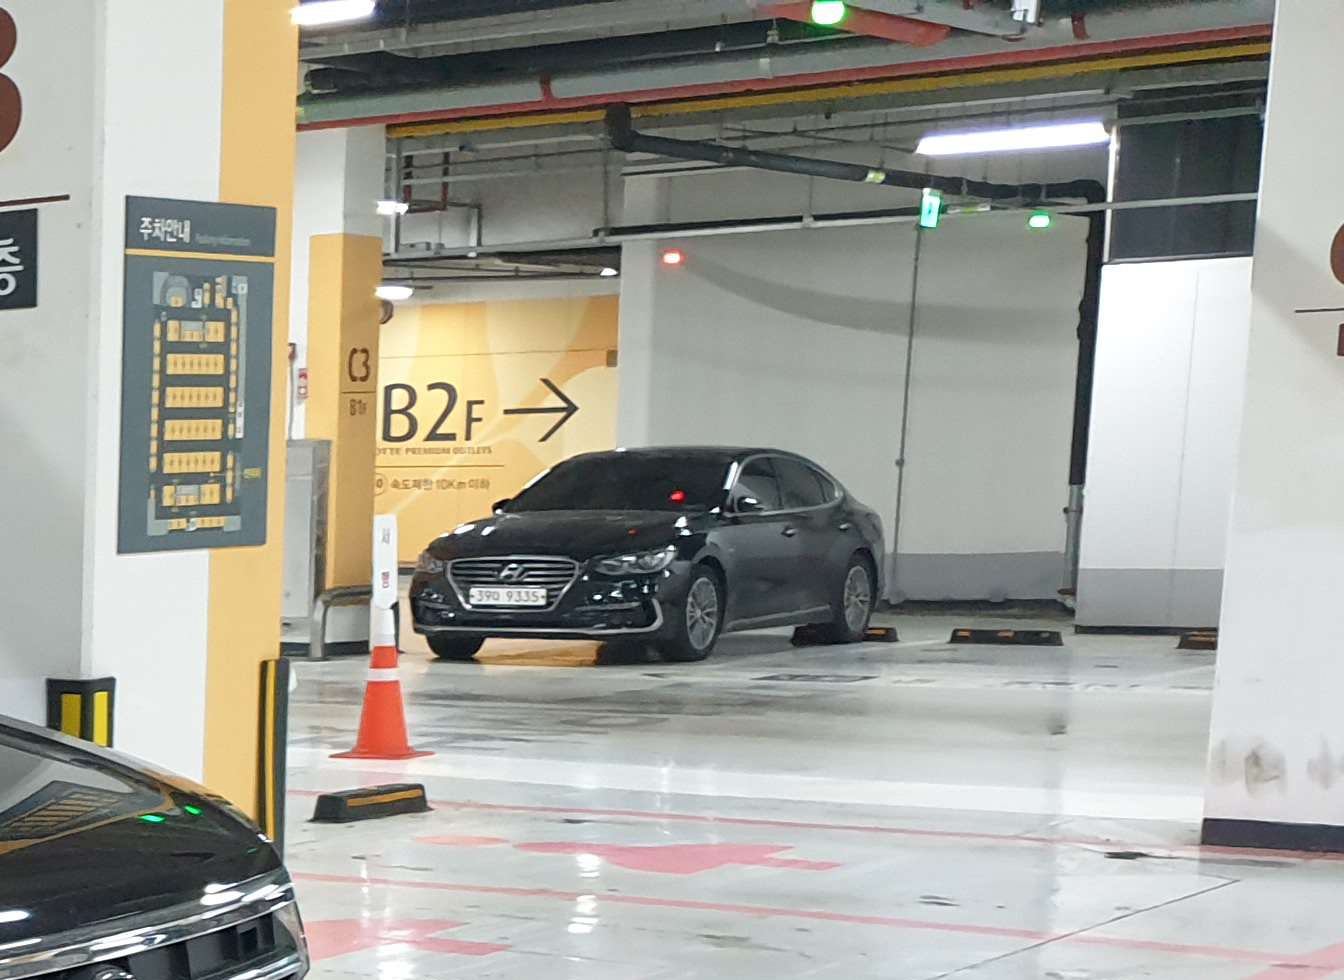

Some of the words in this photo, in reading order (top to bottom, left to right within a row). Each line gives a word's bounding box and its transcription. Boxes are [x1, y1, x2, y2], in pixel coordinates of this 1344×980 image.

[139, 217, 190, 243] 주차안내
[348, 347, 371, 382] C3
[382, 381, 485, 443] B2F
[376, 447, 401, 455] OTTE
